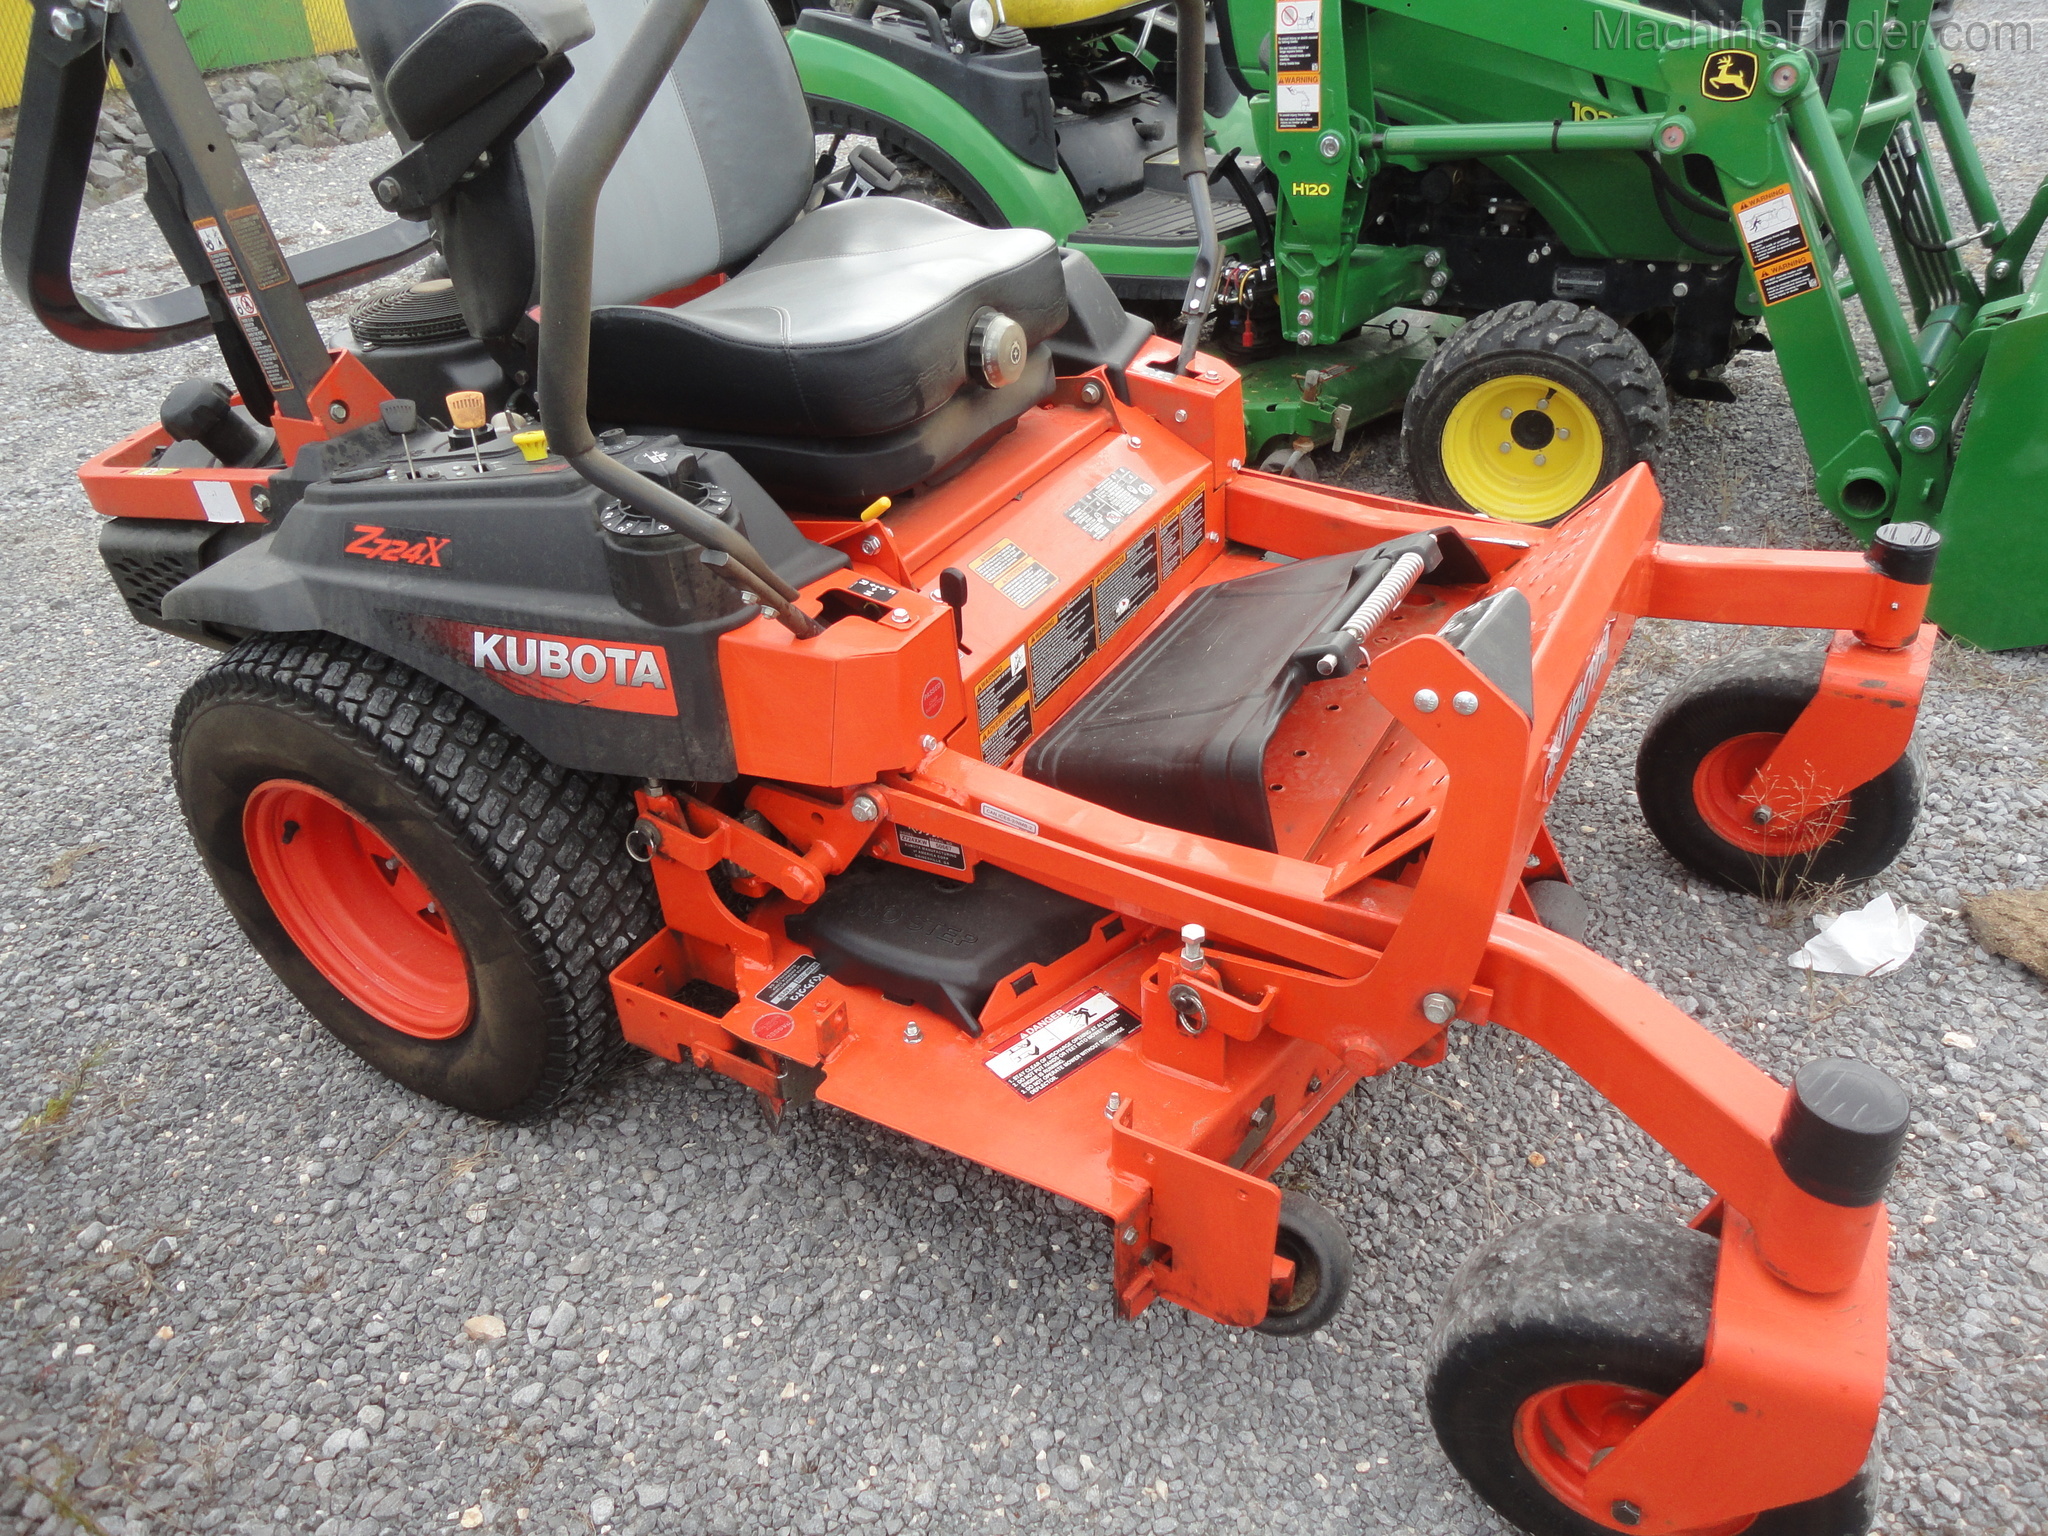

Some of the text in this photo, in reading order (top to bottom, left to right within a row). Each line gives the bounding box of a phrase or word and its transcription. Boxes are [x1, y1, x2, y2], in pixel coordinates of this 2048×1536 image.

[1285, 76, 1319, 84] WARNING
[1292, 182, 1330, 196] H120
[1748, 188, 1785, 206] WARNING
[1770, 256, 1807, 274] WARNING
[344, 524, 451, 568] Z724X
[473, 631, 667, 689] KUBOTA
[981, 666, 1003, 688] WARNING
[987, 704, 1018, 735] ADVERTENCIA
[906, 915, 979, 946] STEP
[789, 973, 826, 1001] Kubota
[1025, 1009, 1066, 1036] DANGER
[1012, 1070, 1027, 1081] STAY
[1024, 1061, 1042, 1073] CLEAR
[1045, 1041, 1073, 1060] DISCHARGE
[1070, 1029, 1092, 1044] OPENING
[1096, 1020, 1107, 1028] ALL
[1024, 1071, 1036, 1079] NOT
[1033, 1065, 1045, 1073] PUT
[1042, 1056, 1060, 1068] HANDS
[1065, 1044, 1079, 1053] FEET
[1086, 1027, 1105, 1040] MOWER
[1102, 1019, 1118, 1030] WHEN
[1032, 1078, 1044, 1086] NOT
[1041, 1065, 1065, 1080] OPERATE
[1062, 1054, 1082, 1067] MOWER
[1079, 1042, 1101, 1056] WITHOUT
[1098, 1027, 1125, 1044] DISCHARGE
[1020, 1075, 1040, 1088] ENGINE
